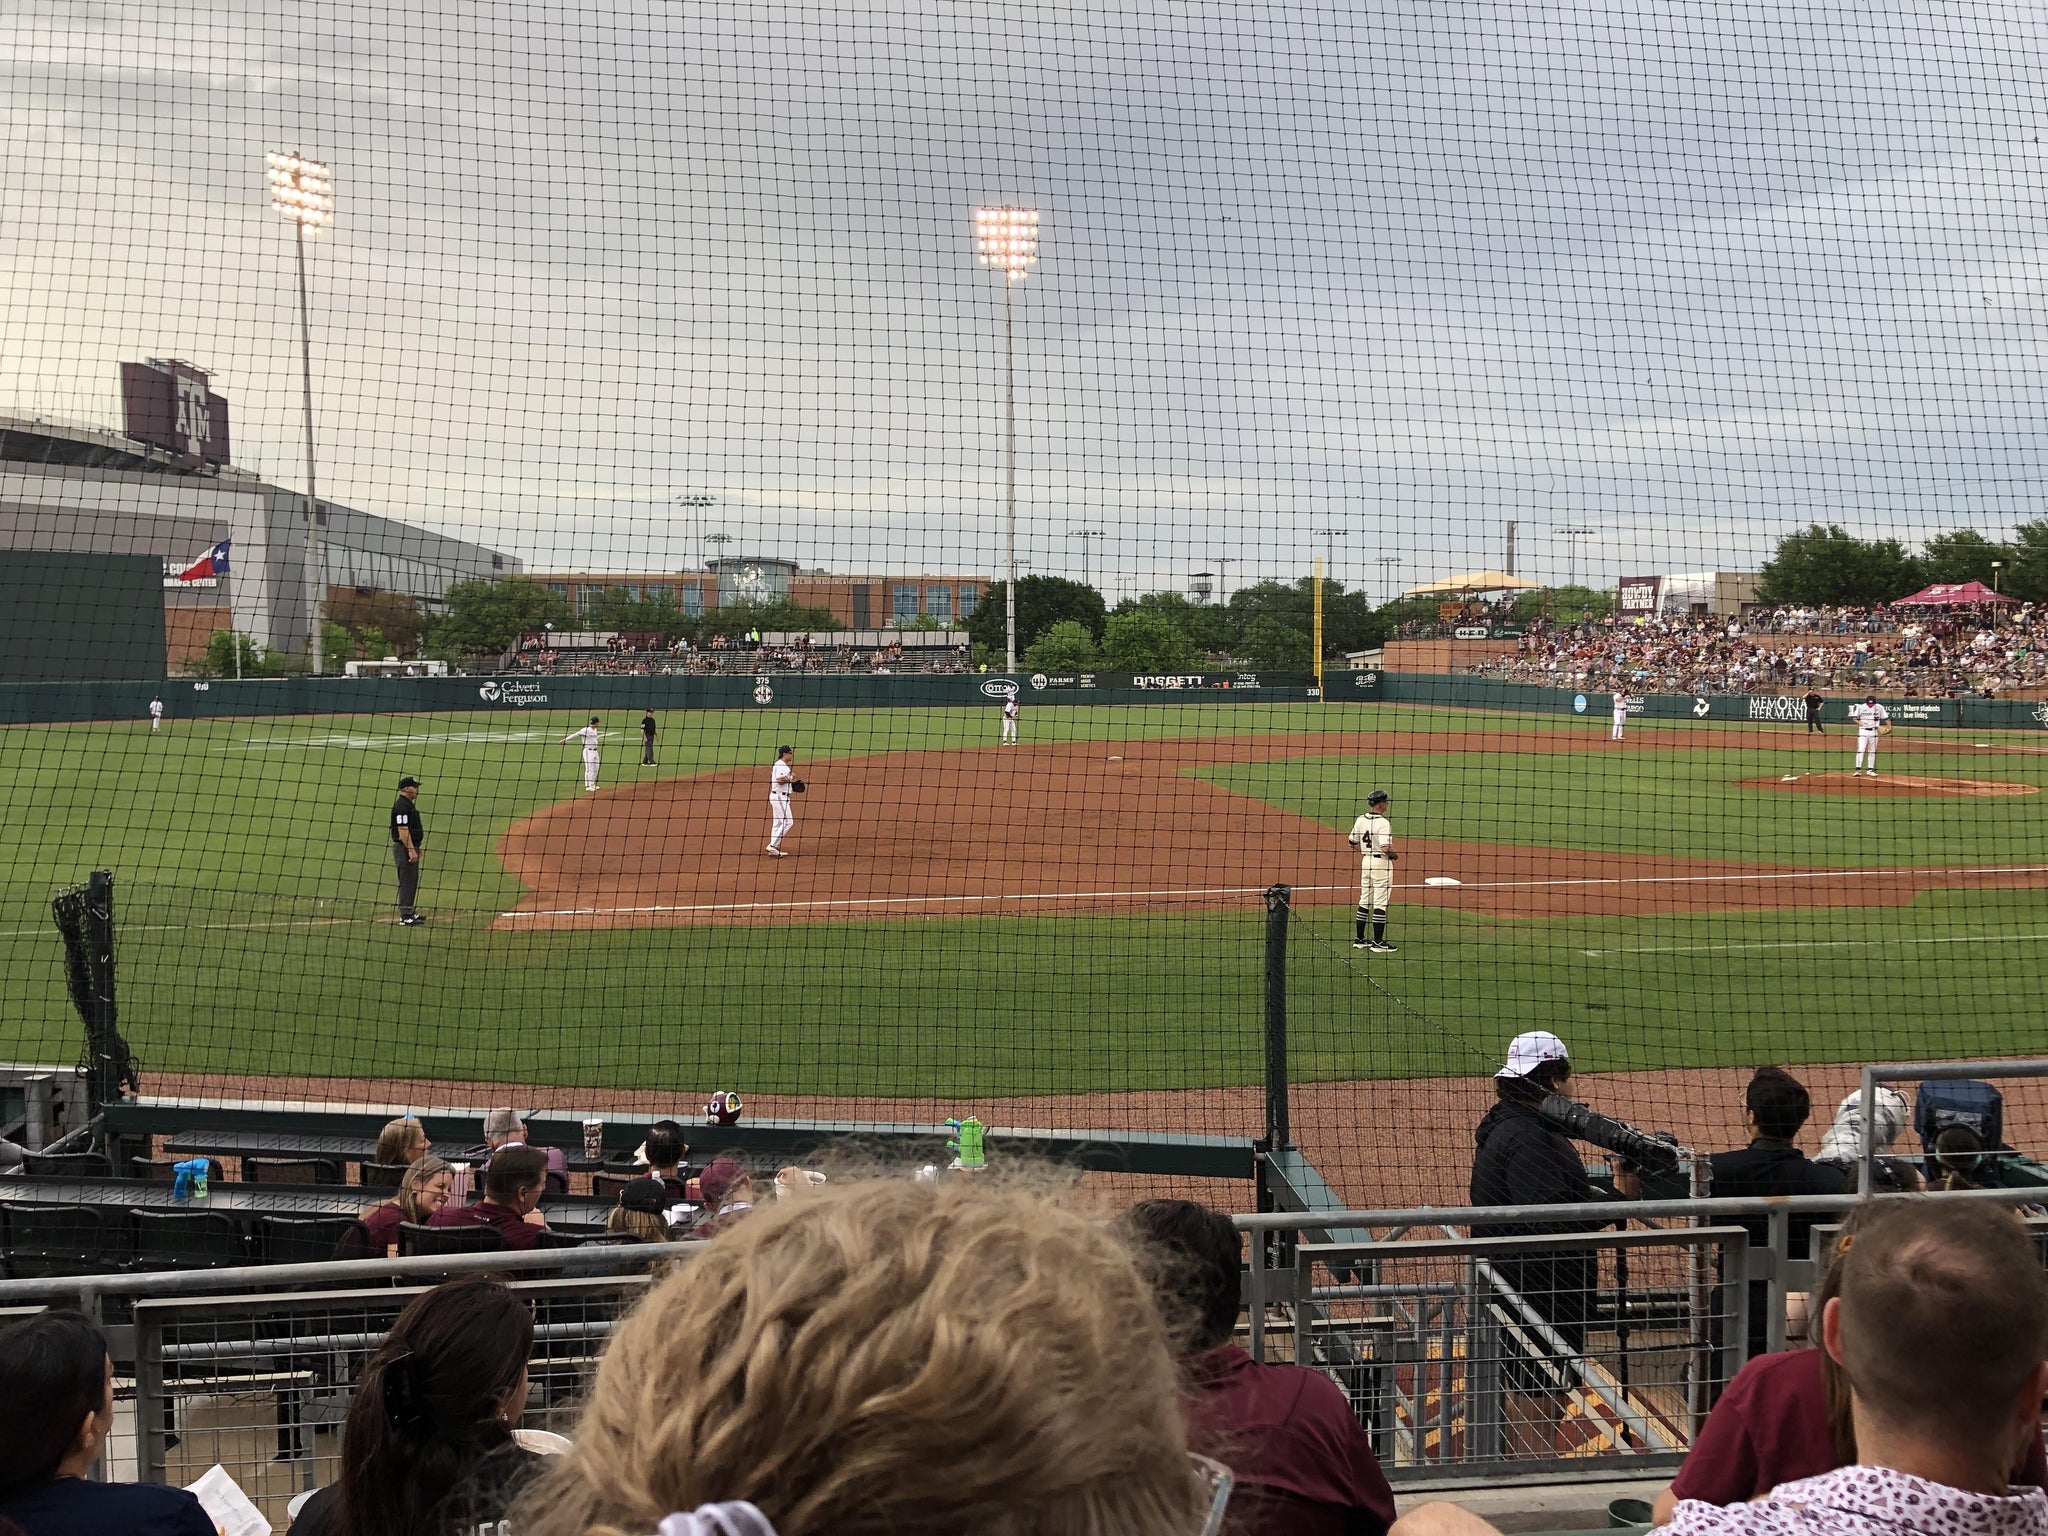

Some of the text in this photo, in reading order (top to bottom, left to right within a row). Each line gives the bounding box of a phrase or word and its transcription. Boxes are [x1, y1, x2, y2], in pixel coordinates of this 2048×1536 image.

[1622, 599, 1654, 609] PARTNER
[1306, 688, 1320, 696] 330
[502, 692, 548, 706] Ferguson
[1749, 696, 1808, 710] MEMORIA
[1626, 705, 1644, 713] ARGO
[1362, 830, 1372, 848] 4
